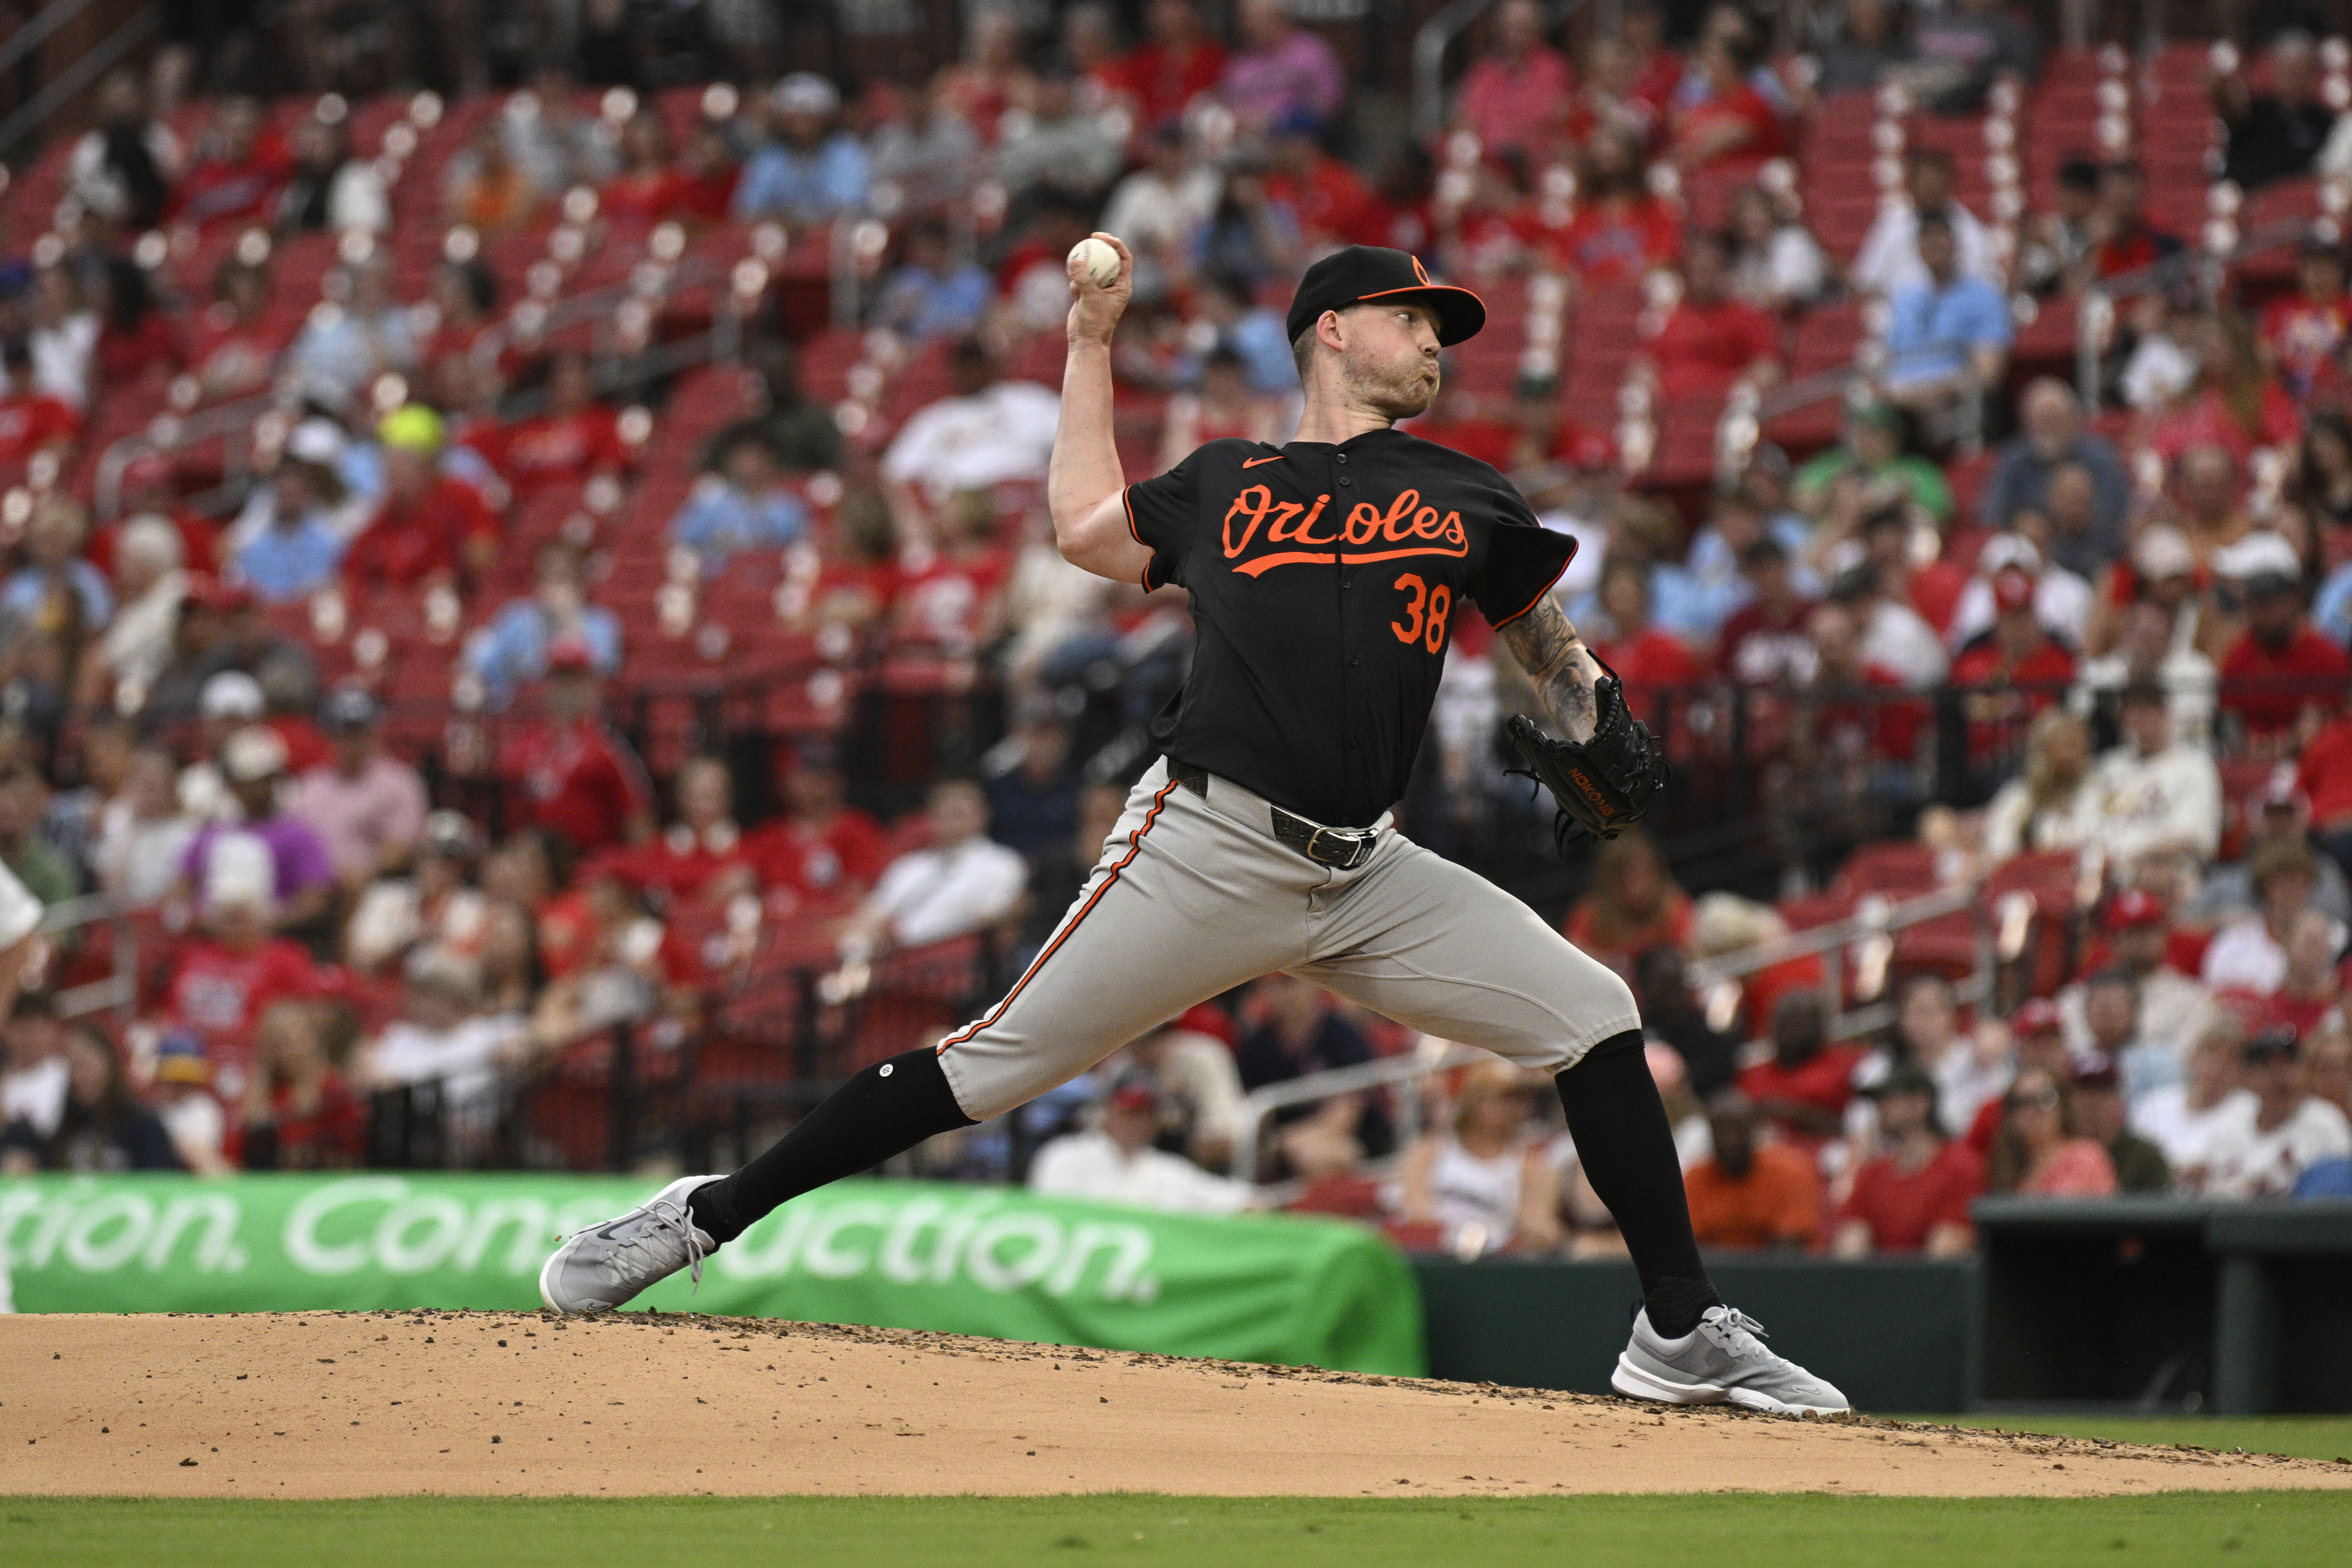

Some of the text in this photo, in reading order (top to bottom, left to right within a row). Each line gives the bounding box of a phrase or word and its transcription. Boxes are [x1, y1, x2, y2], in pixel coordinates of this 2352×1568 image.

[1222, 484, 1469, 560] Orioles
[1392, 572, 1451, 654] 38
[1355, 847, 1372, 863] 38
